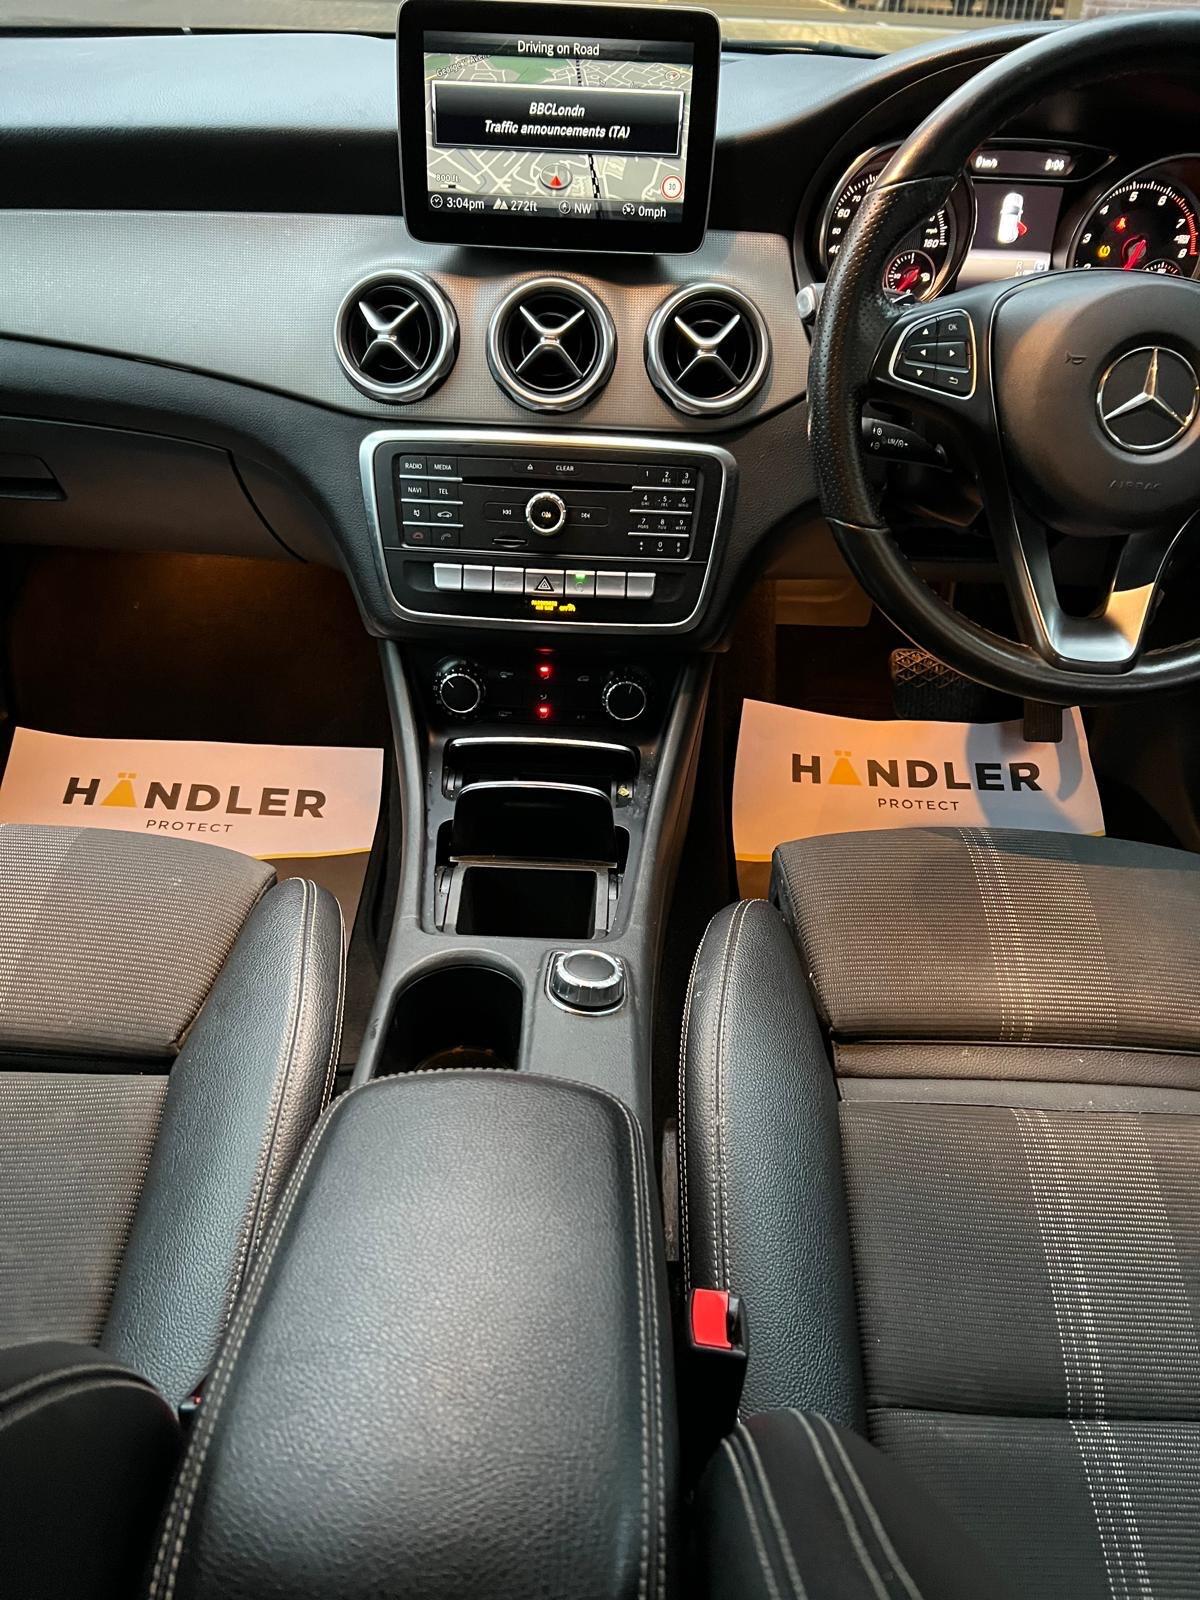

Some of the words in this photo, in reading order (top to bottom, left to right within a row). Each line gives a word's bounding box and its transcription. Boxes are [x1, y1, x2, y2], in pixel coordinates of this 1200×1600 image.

[517, 40, 554, 56] Driving
[556, 44, 570, 54] on
[573, 42, 600, 56] Road
[529, 102, 586, 117] BBCLondn
[484, 120, 518, 134] Traffic
[520, 124, 606, 138] announcements
[608, 126, 631, 139] (TA)
[436, 174, 451, 182] 800
[1128, 191, 1139, 202] 5
[1157, 195, 1168, 206] 6
[446, 197, 485, 211] 3:04pm
[511, 200, 538, 212] 272ft
[574, 203, 592, 214] NW
[1099, 204, 1110, 215] 4
[638, 205, 667, 220] 0mph
[837, 208, 851, 218] 60
[1175, 218, 1186, 229] 7
[1082, 233, 1092, 244] 3
[948, 323, 958, 331] OK
[404, 462, 423, 470] RADIO
[434, 463, 452, 471] MEDIA
[407, 486, 422, 494] NAVI
[790, 750, 1044, 792] HÄNDLER
[62, 771, 328, 819] HÄNDLER
[877, 797, 960, 812] PROTECT
[146, 818, 234, 834] PROTECT
